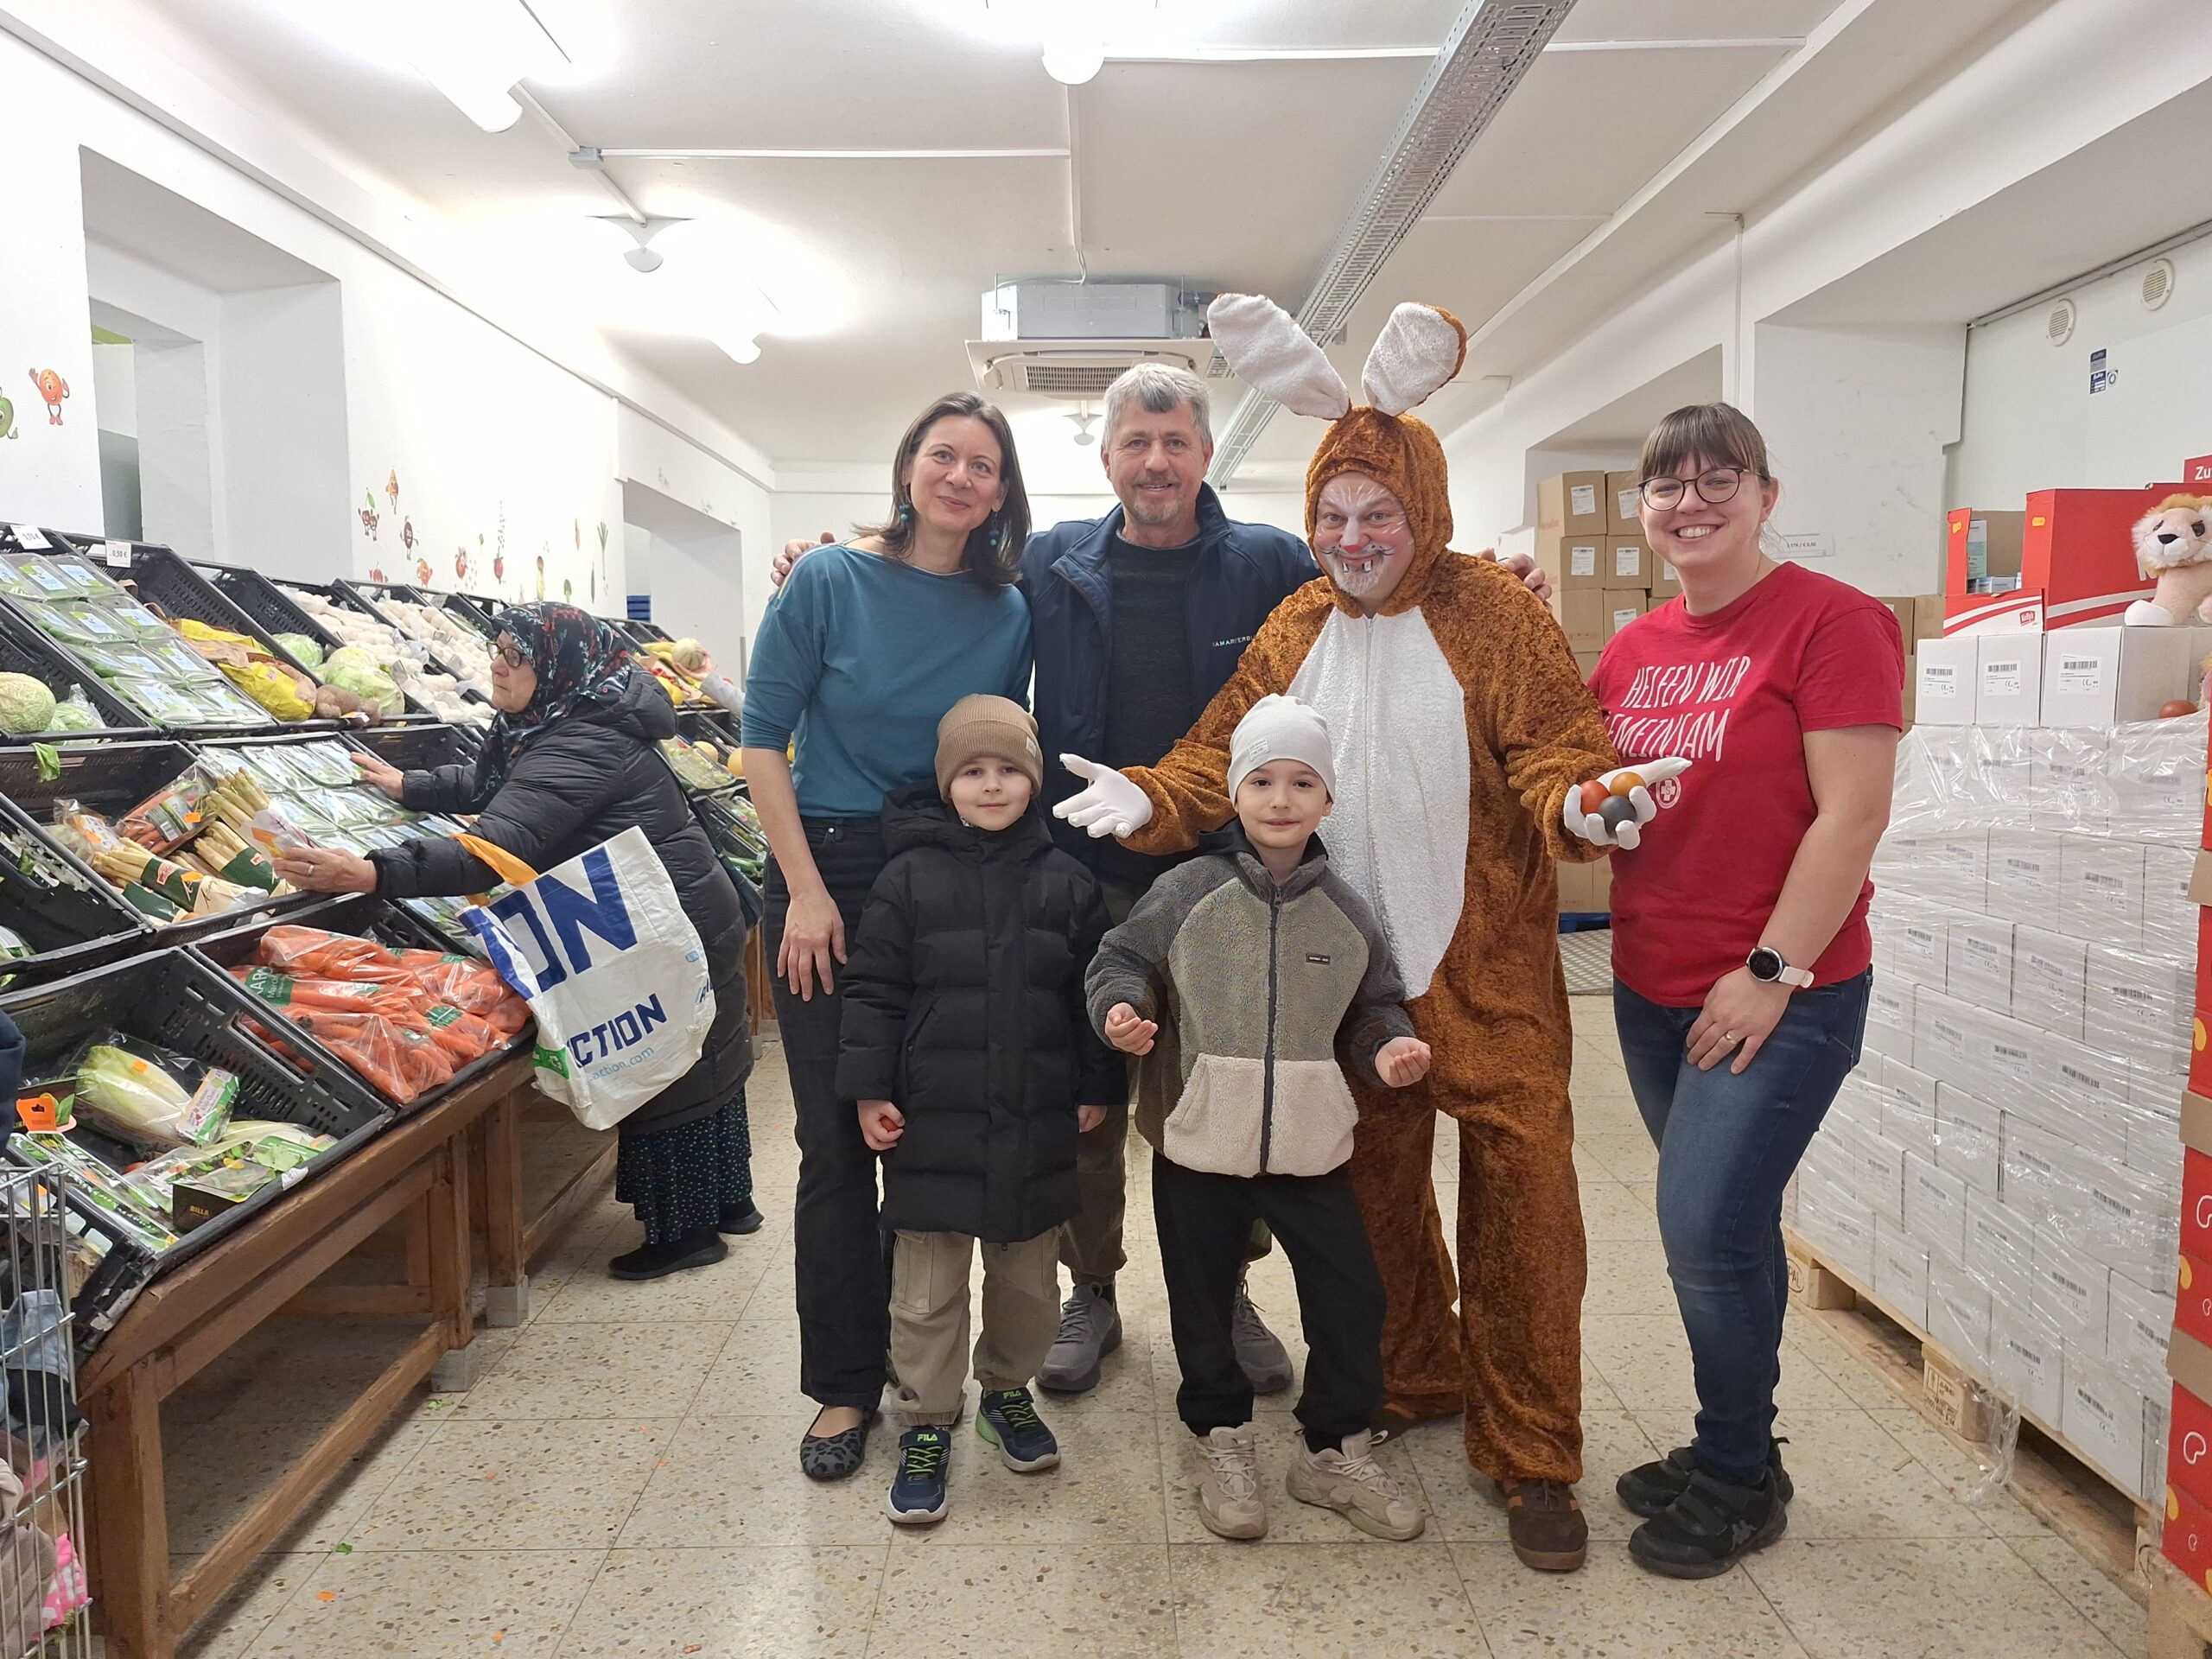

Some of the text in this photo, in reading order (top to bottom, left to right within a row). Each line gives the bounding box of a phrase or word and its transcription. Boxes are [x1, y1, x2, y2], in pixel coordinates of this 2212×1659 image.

[1620, 656, 1751, 709] HELFEN WIR
[566, 993, 668, 1070] CTION
[190, 1205, 210, 1217] BILLA
[1003, 1389, 1022, 1400] FILA
[917, 1433, 938, 1442] FILA
